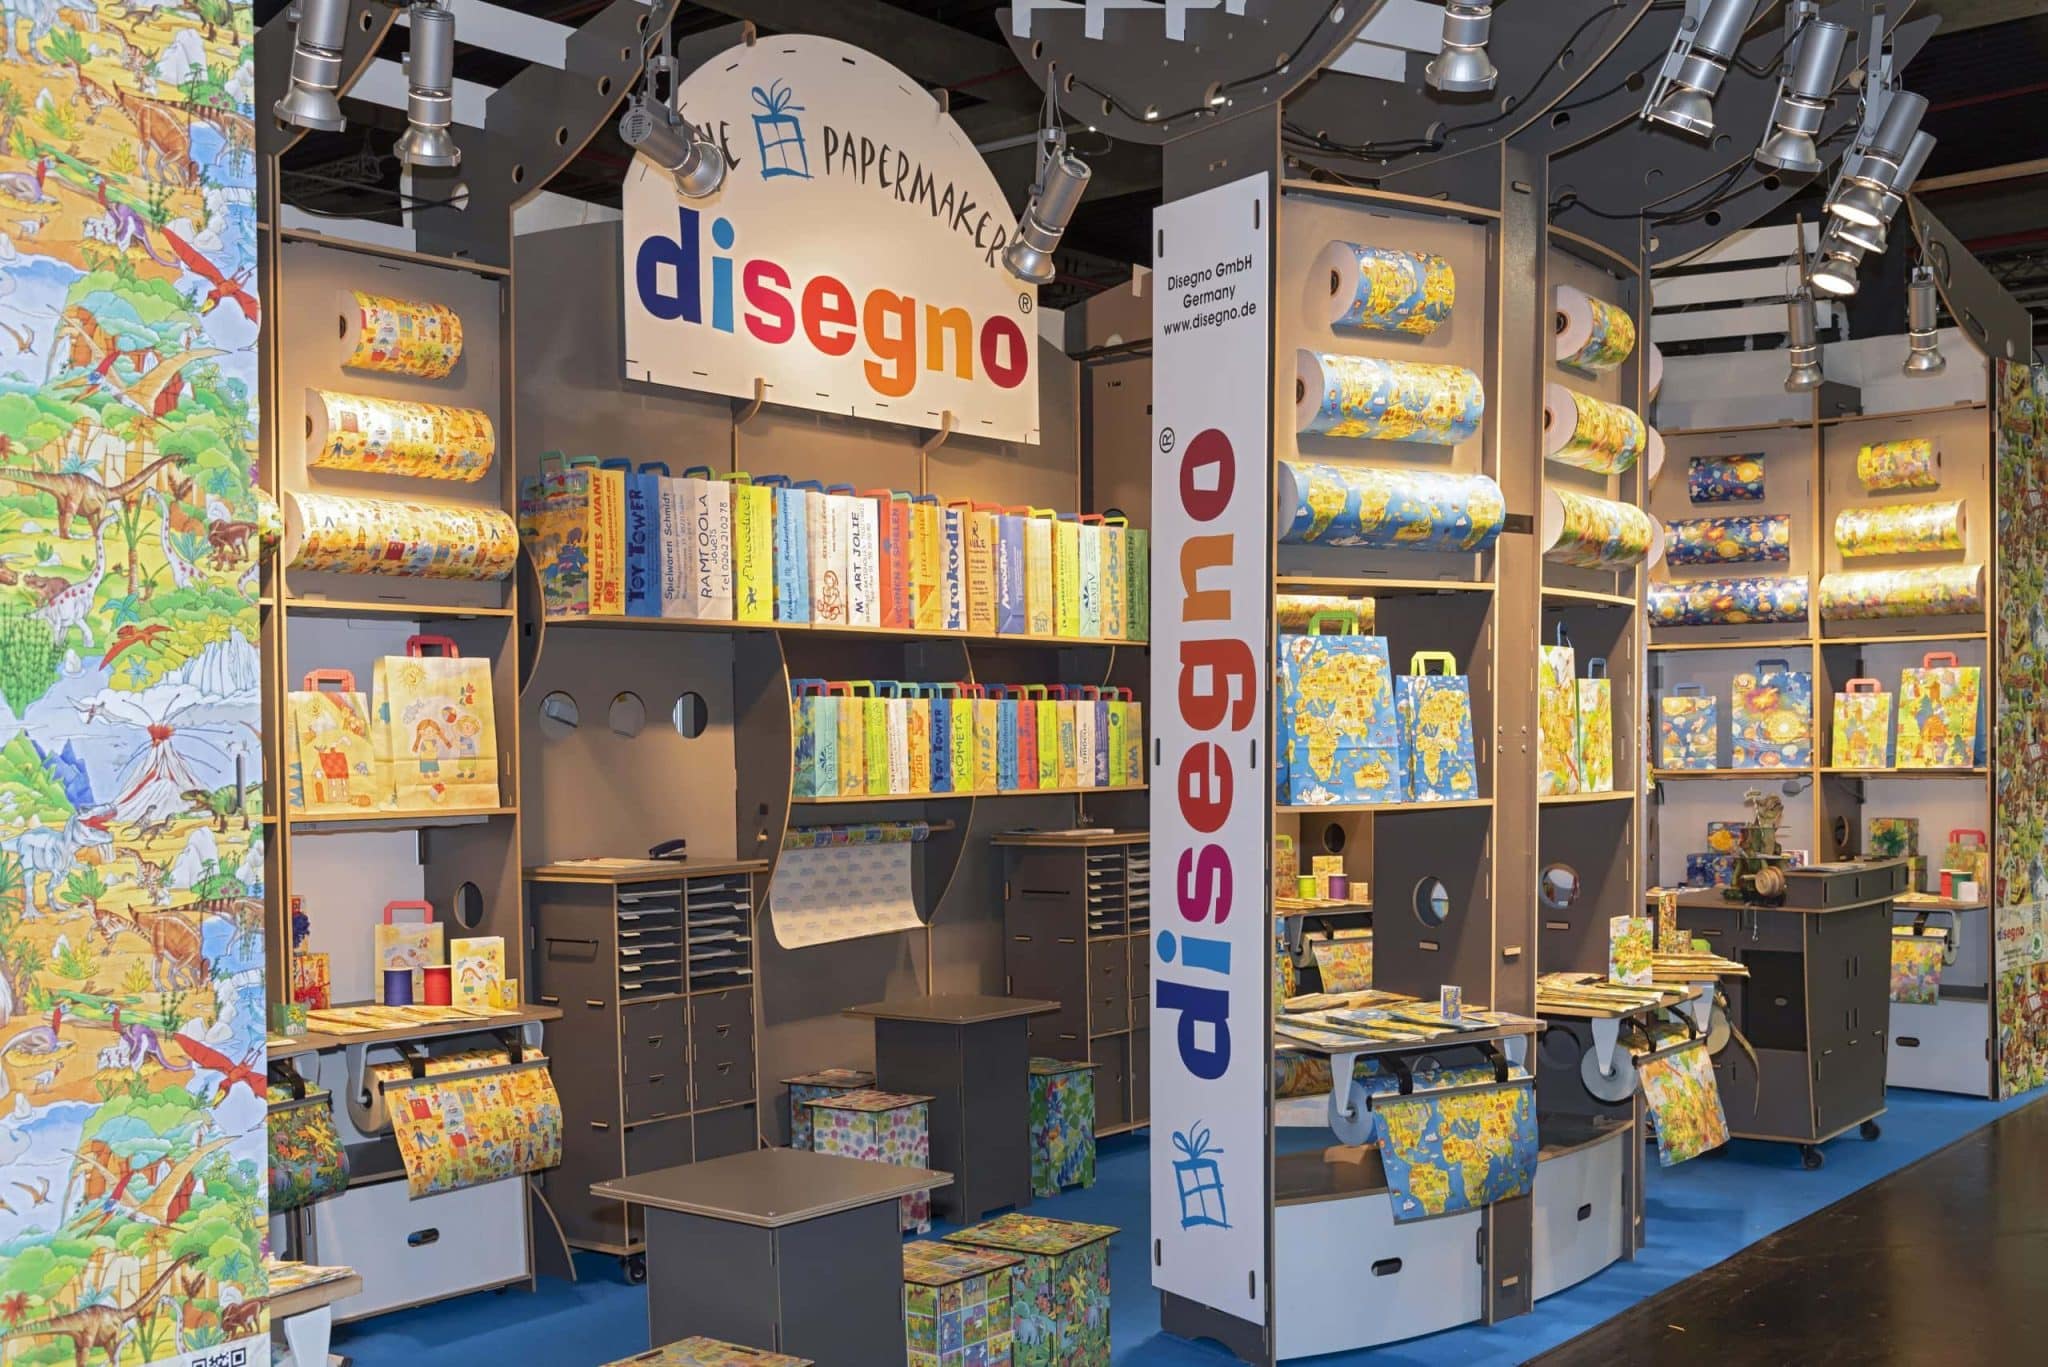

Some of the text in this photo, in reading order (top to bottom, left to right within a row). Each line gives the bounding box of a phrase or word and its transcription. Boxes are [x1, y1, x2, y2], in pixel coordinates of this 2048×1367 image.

[823, 125, 1007, 269] PAPERMAKER
[636, 207, 1029, 397] disegno
[1167, 254, 1252, 291] Disegno GmbH
[1183, 285, 1236, 309] Germany
[1163, 301, 1257, 336] www.disegno.de
[592, 473, 604, 611] JUGUETES AVANT
[627, 489, 646, 603] TOY TOWER
[662, 491, 676, 600] Spielwaren Schmidt
[697, 494, 713, 598] RAMTOOLA
[709, 528, 718, 565] Jouets
[851, 511, 862, 557] JOLIE
[852, 562, 862, 592] ART
[954, 713, 966, 777] KOMETA
[980, 726, 991, 771] KIDS
[1156, 427, 1257, 1082] disegno
